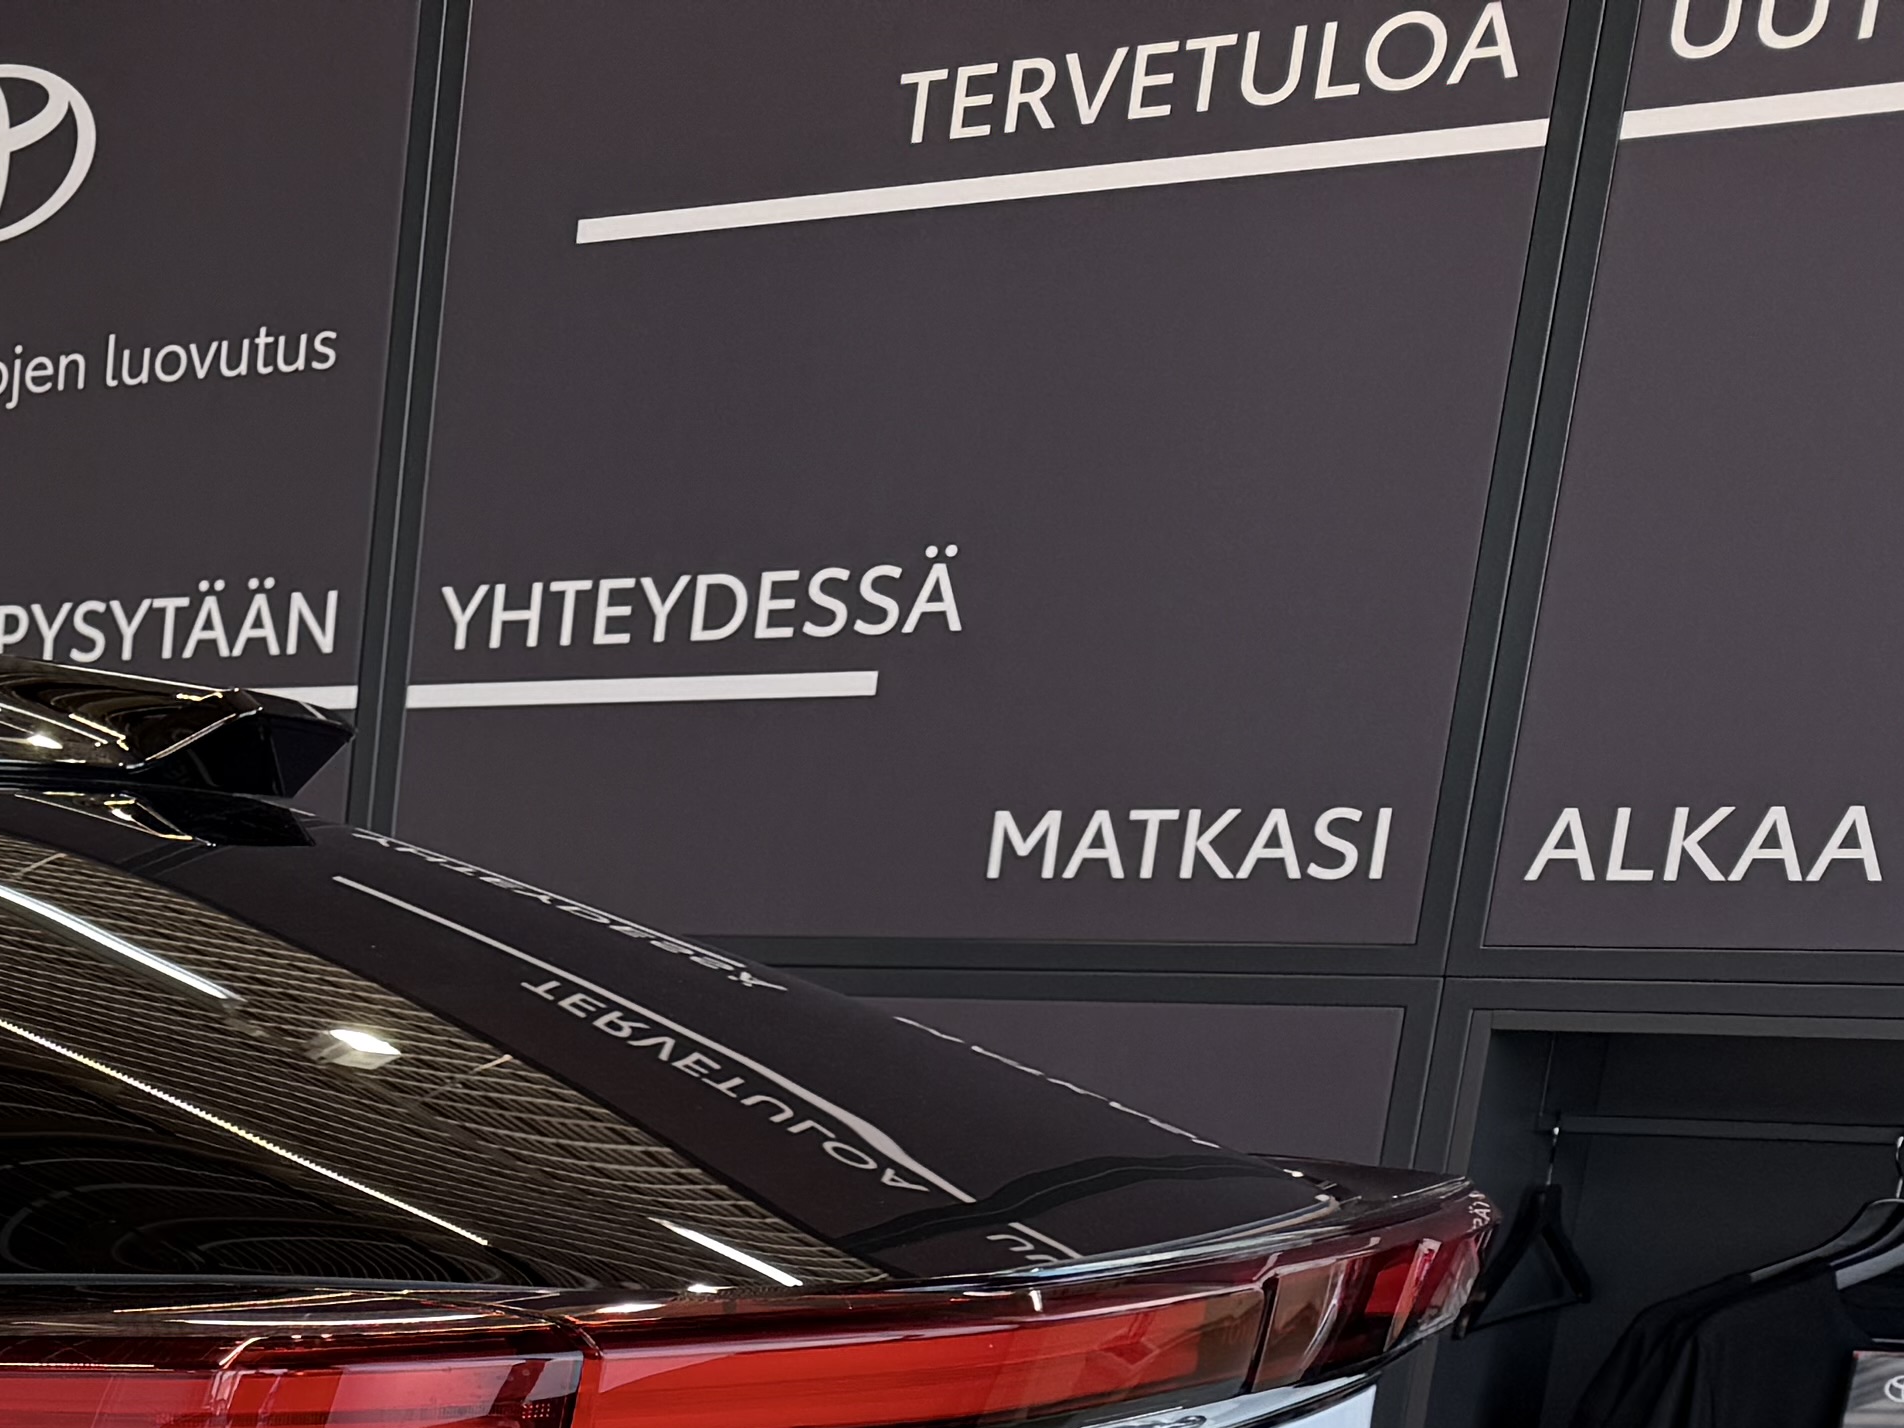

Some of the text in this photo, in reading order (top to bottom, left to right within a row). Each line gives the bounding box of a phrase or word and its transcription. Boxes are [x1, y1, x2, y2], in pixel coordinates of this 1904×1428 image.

[900, 2, 1519, 144] TERVETULOA
[105, 326, 338, 389] luovutus
[441, 544, 962, 651] YHTEYDESSÄ
[987, 805, 1885, 882] MATKASI ALKAA
